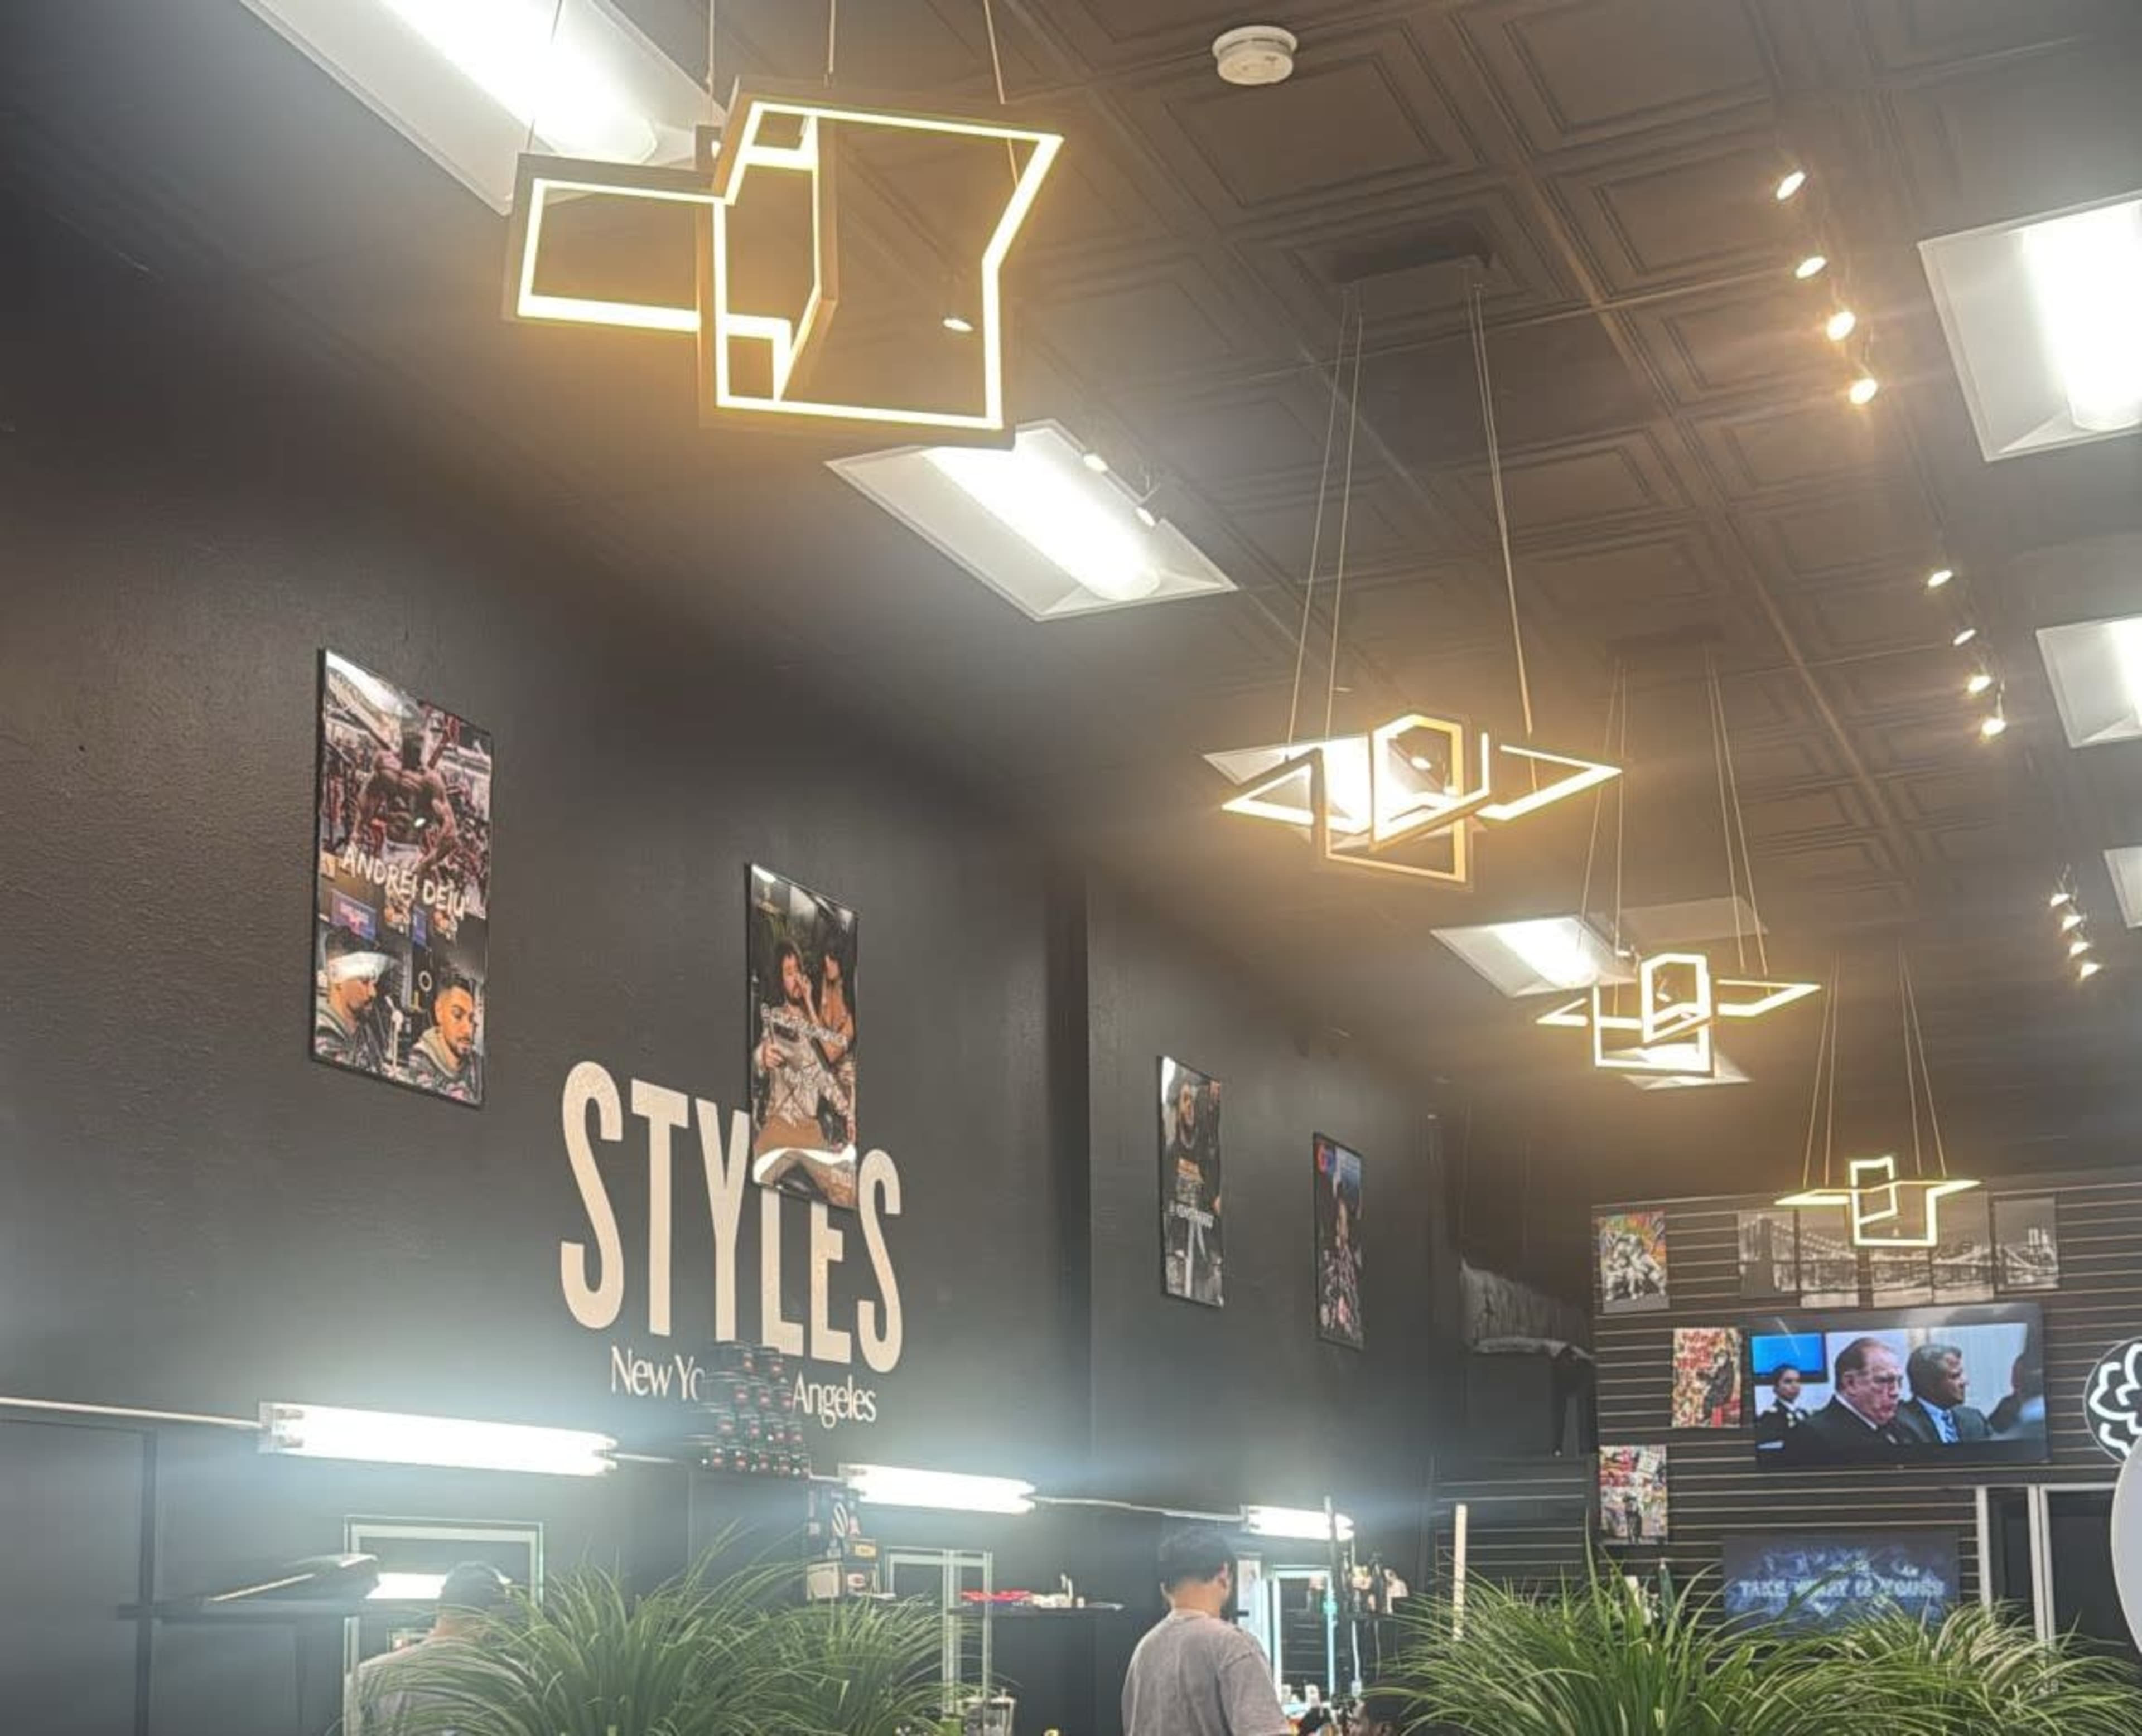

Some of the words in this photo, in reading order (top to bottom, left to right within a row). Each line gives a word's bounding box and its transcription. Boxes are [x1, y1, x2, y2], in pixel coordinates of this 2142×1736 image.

[561, 1061, 903, 1373] STYLES
[611, 1345, 673, 1397] New
[793, 1370, 877, 1429] Angeles
